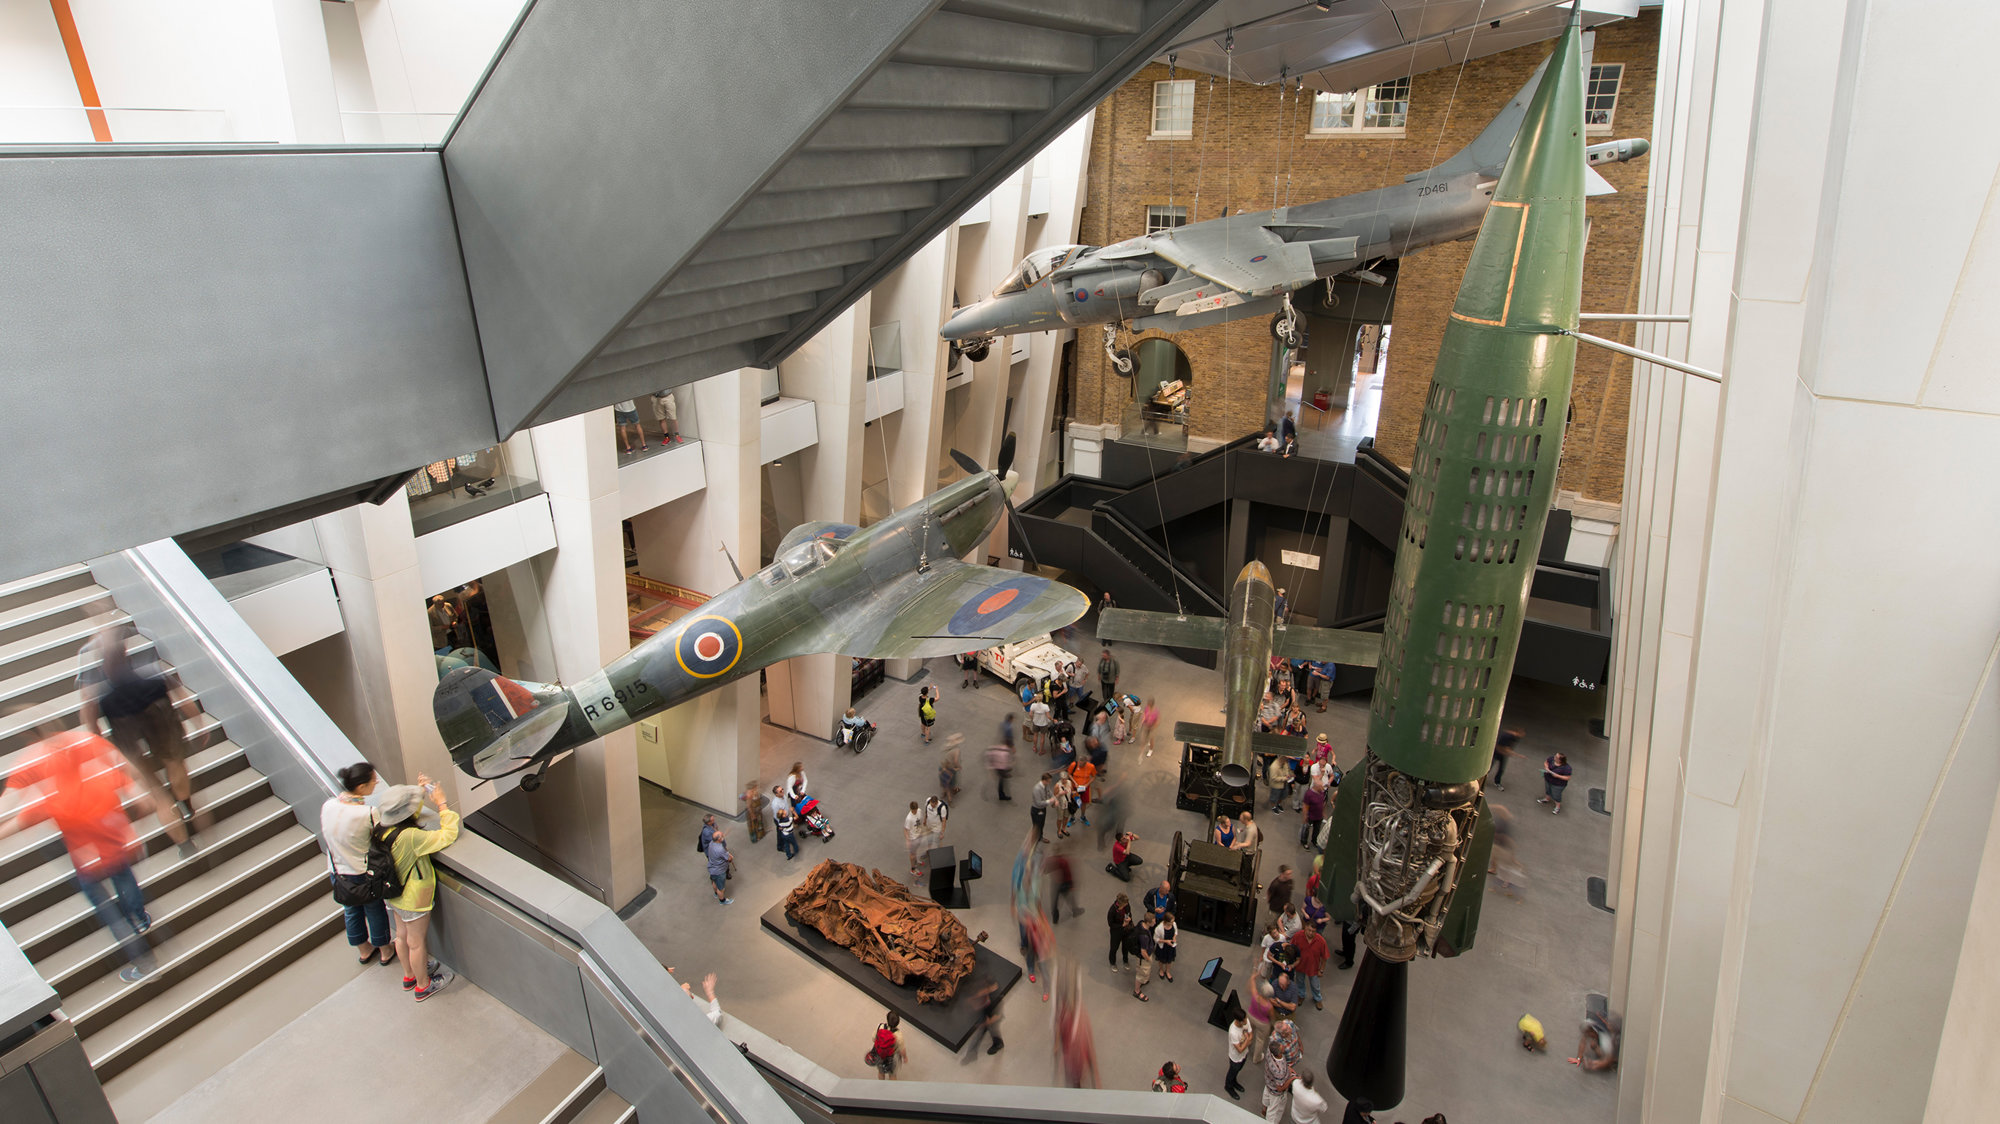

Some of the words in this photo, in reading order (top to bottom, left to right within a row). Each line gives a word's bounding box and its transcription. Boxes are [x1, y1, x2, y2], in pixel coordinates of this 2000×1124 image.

[1418, 182, 1448, 197] ZD461
[994, 652, 1005, 664] TV
[584, 678, 648, 721] R6915
